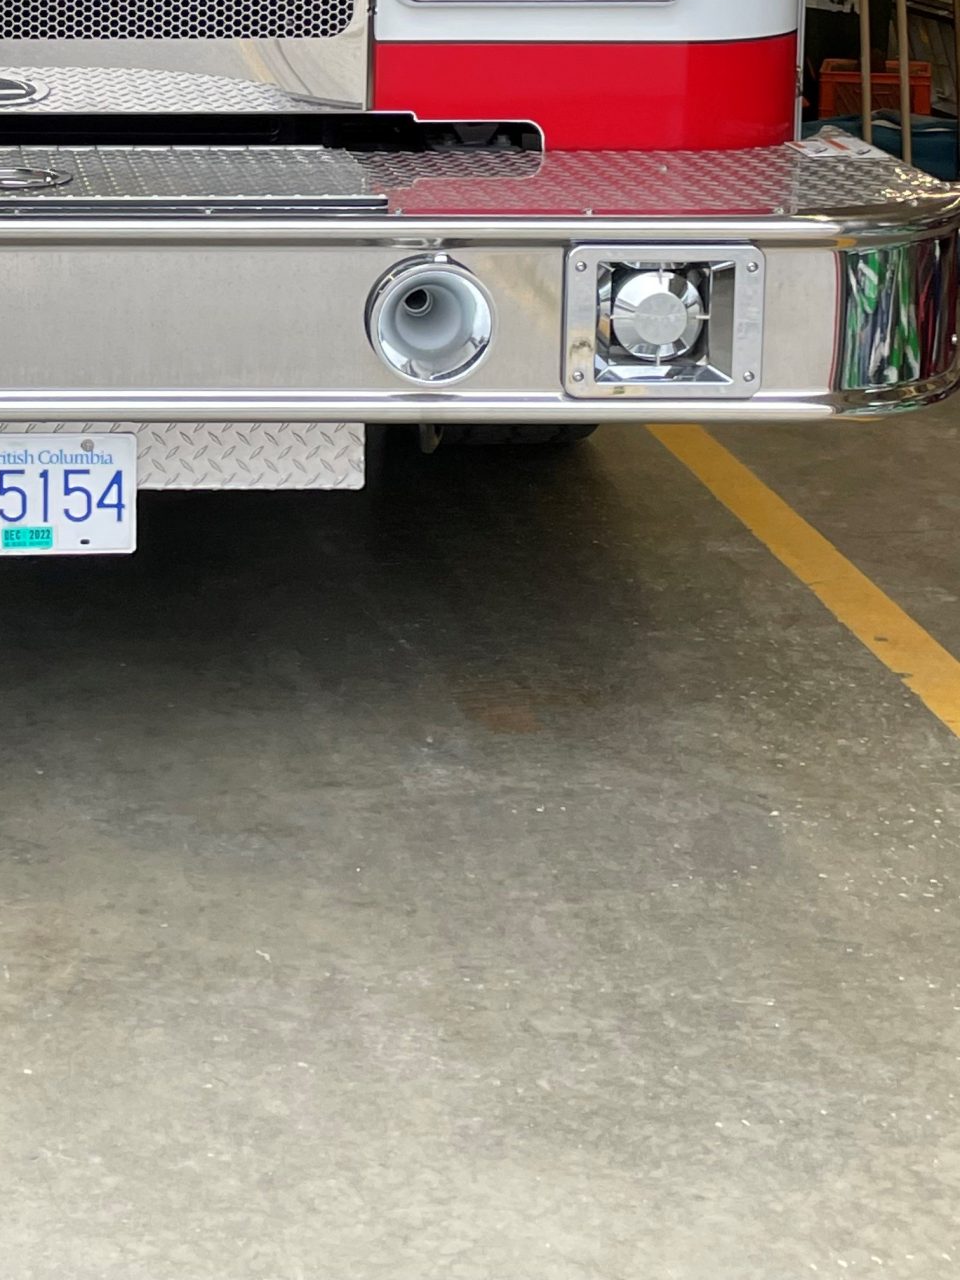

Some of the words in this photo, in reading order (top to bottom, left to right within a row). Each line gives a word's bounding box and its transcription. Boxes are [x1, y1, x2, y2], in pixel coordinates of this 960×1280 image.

[38, 450, 113, 465] Columbia
[4, 529, 21, 541] DEC
[29, 528, 51, 540] 2022
